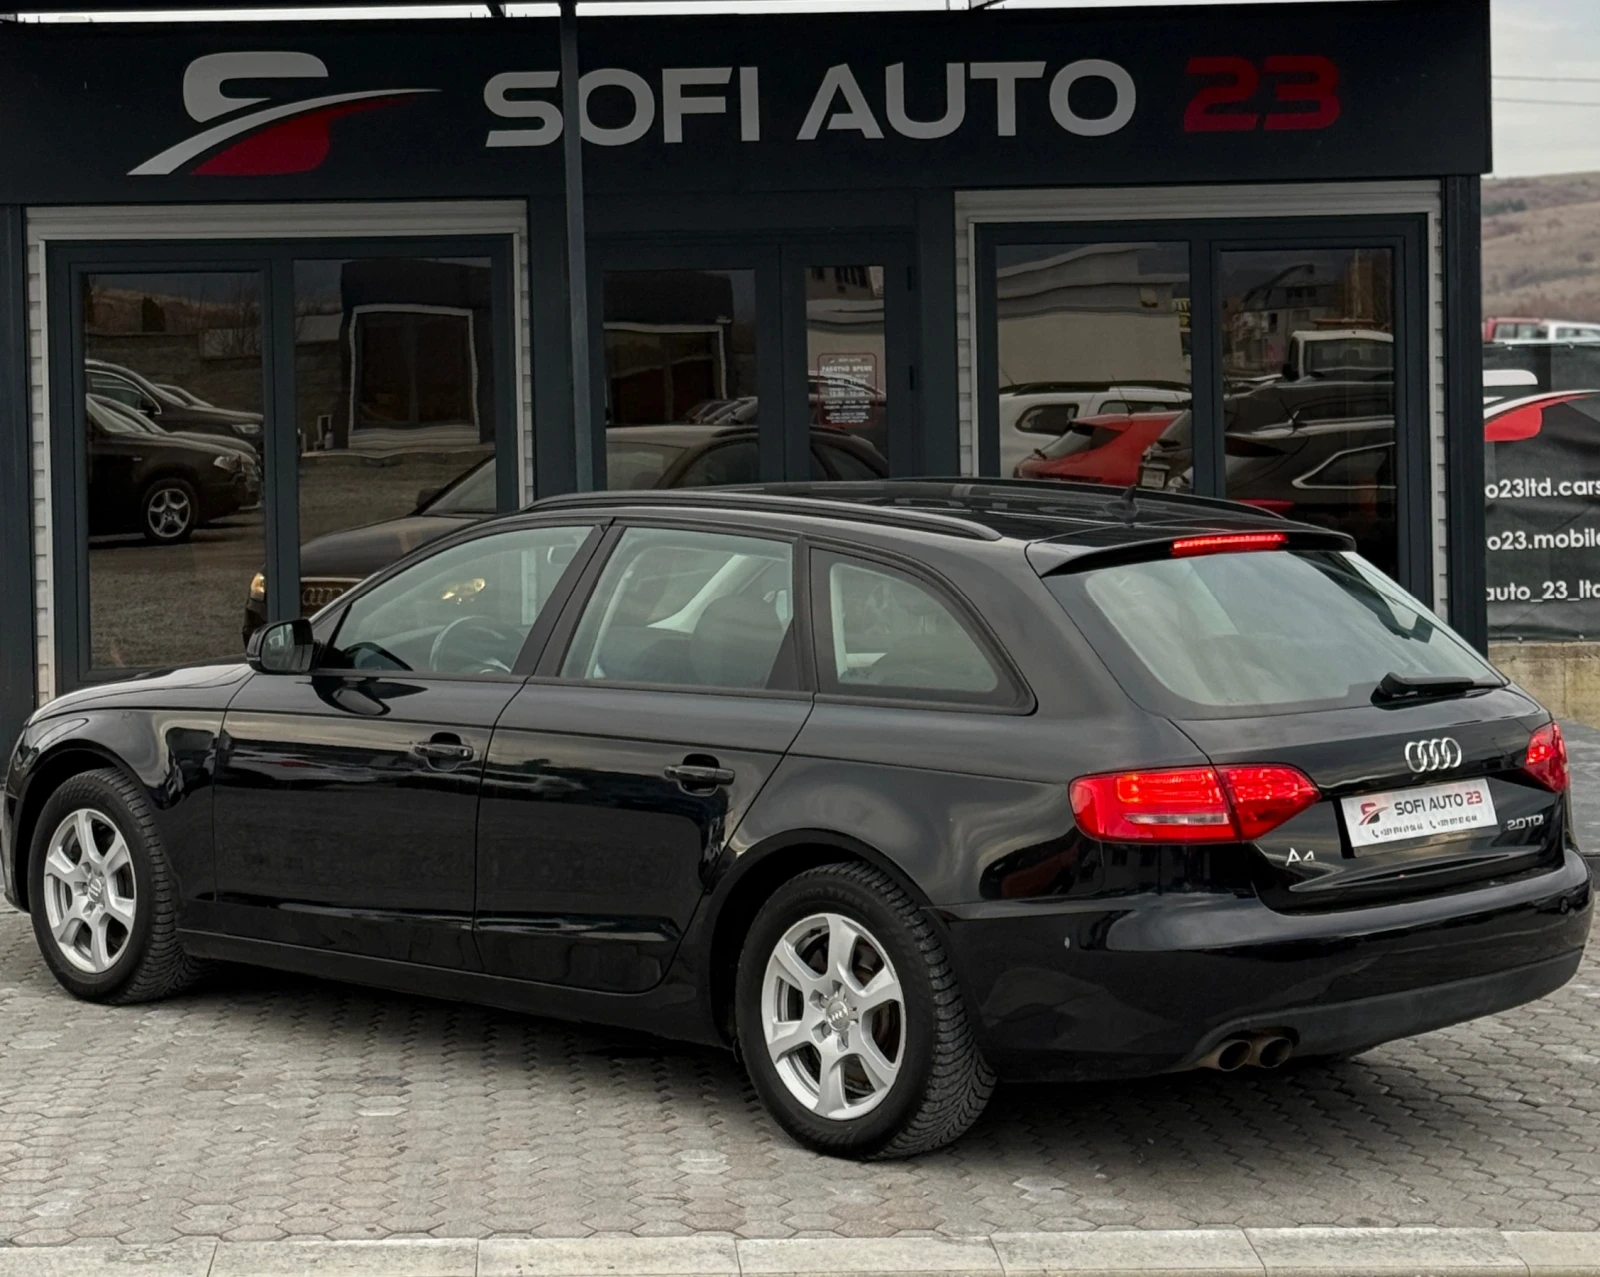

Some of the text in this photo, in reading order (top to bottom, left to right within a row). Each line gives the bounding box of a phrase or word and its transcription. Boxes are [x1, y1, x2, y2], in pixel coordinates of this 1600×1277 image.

[484, 55, 1341, 147] SOFI AUTO 23
[1394, 790, 1483, 816] SOFI AUTO 23
[1285, 846, 1316, 867] A4
